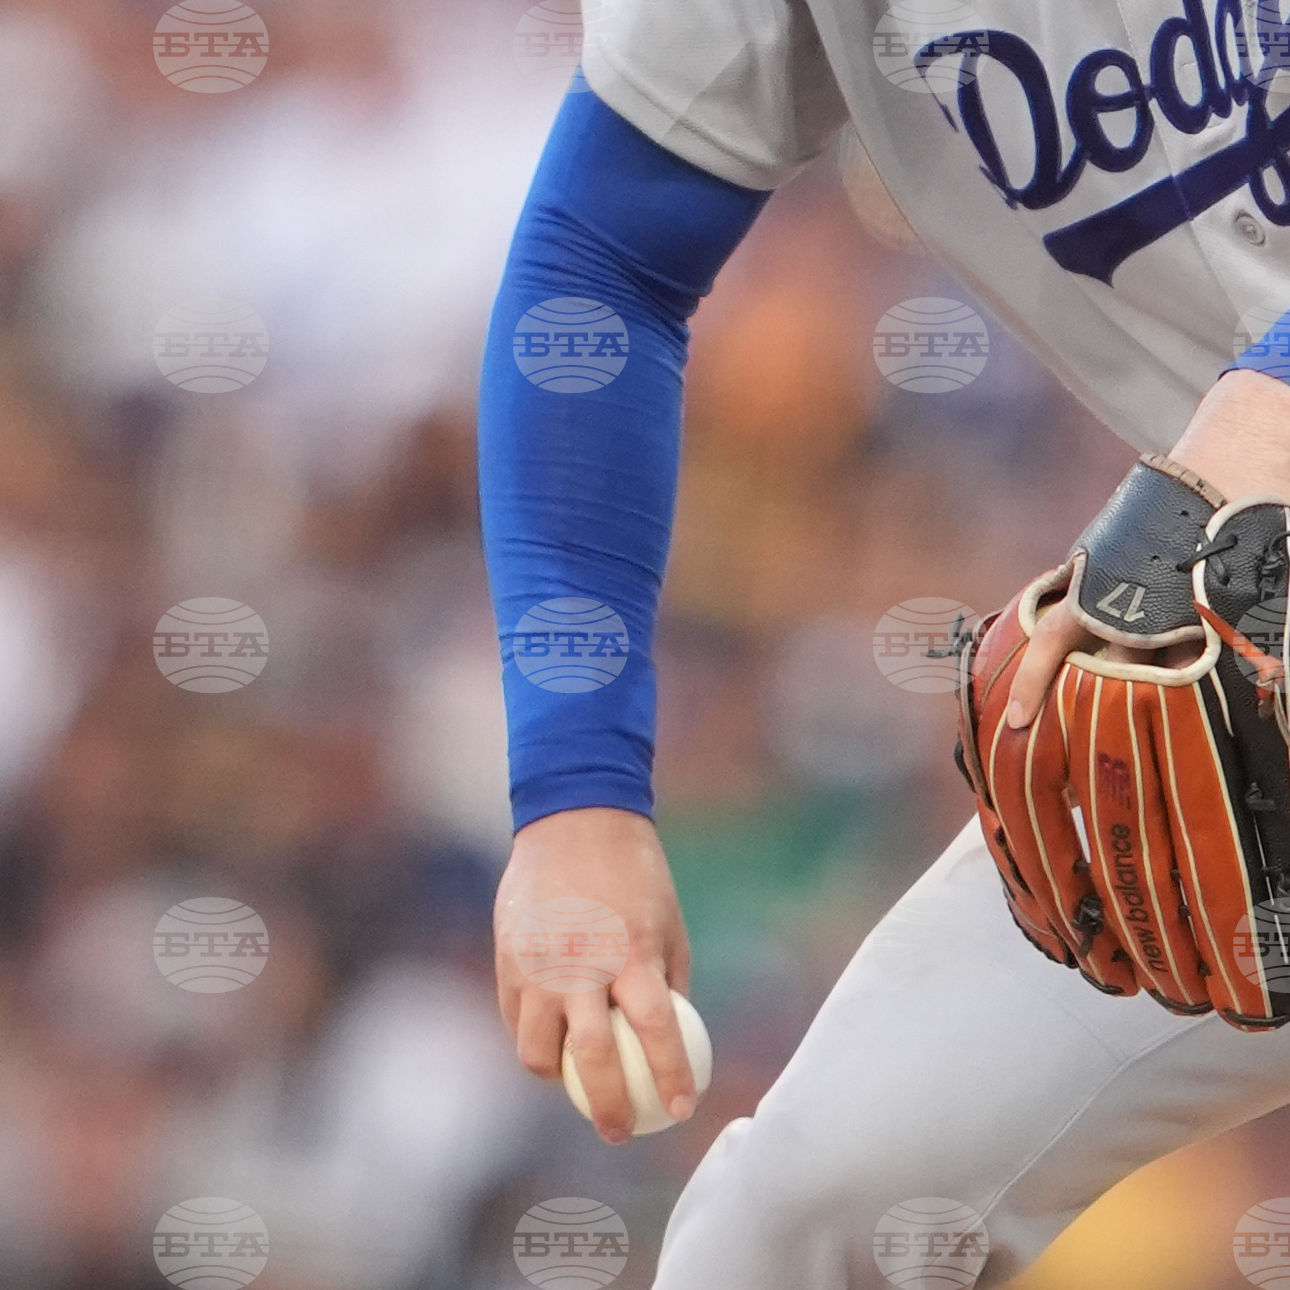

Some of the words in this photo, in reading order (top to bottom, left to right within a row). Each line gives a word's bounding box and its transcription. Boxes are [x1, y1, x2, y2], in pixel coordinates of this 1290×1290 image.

[1096, 582, 1146, 622] 17
[1110, 823, 1149, 923] balance
[1133, 925, 1168, 973] new
